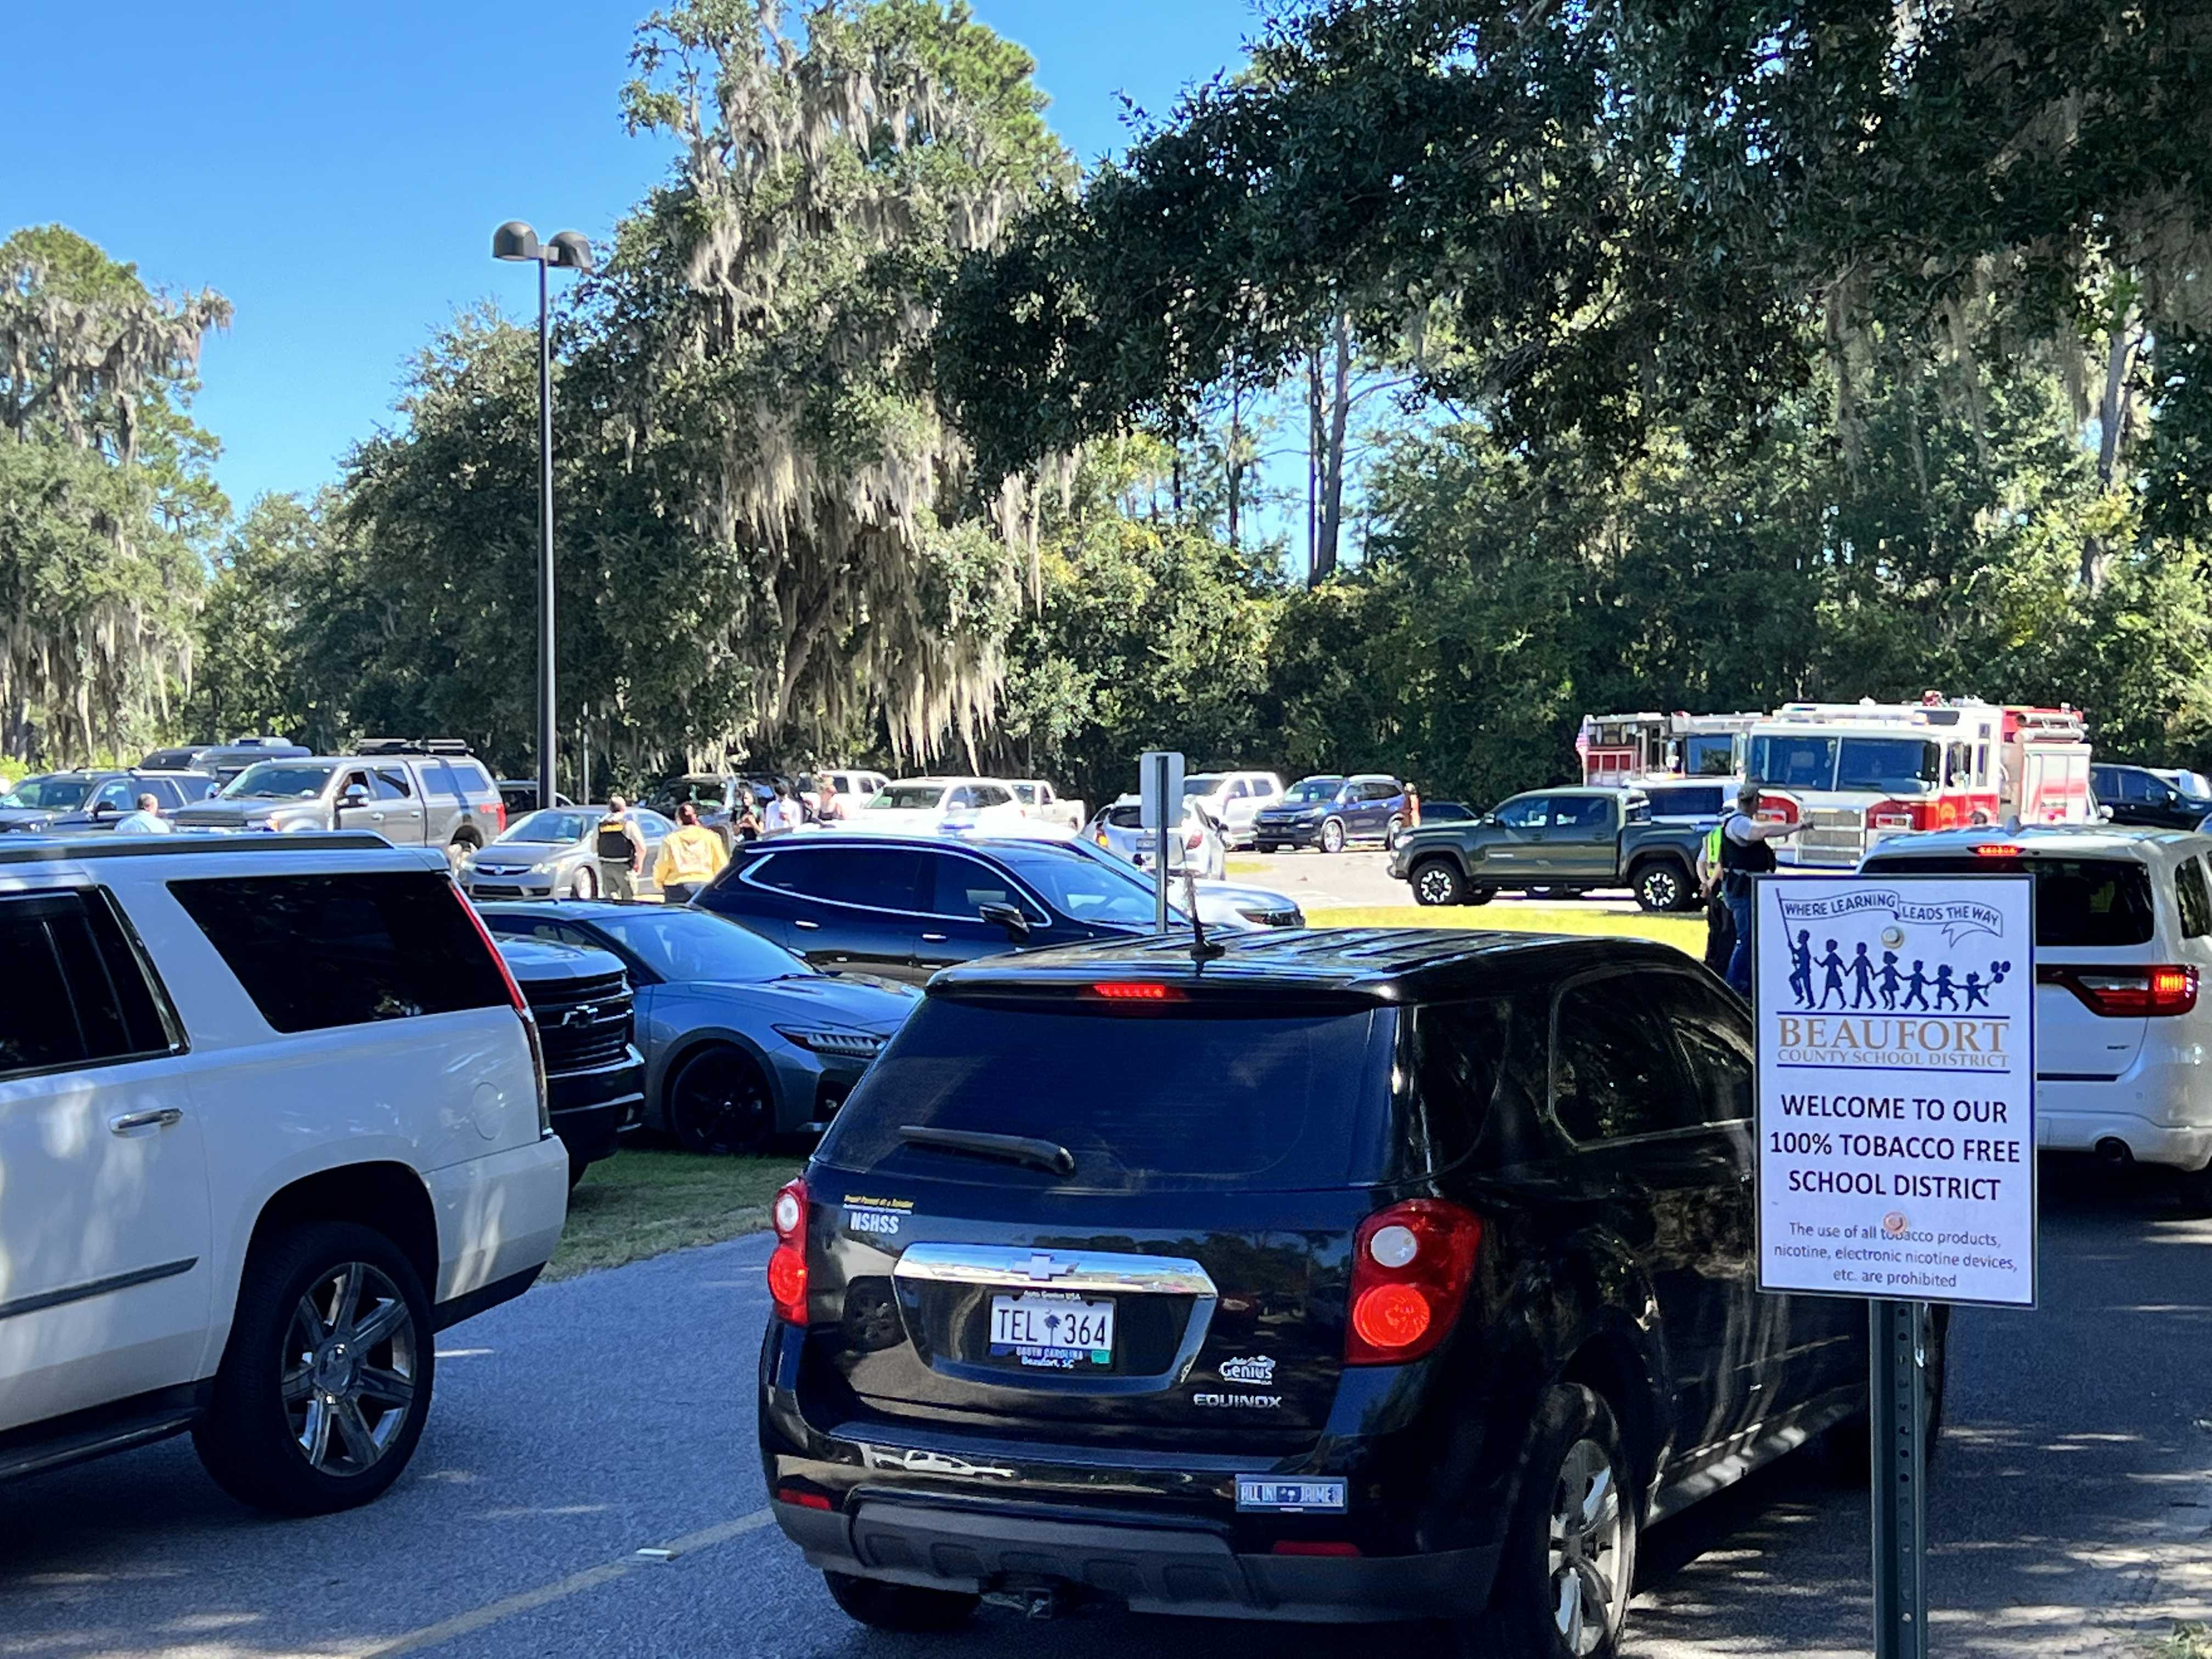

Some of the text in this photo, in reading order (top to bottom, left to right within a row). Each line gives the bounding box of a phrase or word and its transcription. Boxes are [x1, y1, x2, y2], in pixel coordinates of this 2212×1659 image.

[1785, 894, 1999, 926] WHERE LEARNING LEADS THE WAY
[1778, 1017, 2010, 1052] BEAUFORT
[1778, 1048, 2009, 1067] COUNTY SCHOOL DISTRICT
[1781, 1094, 2007, 1124] WELCOME TO OUR
[1770, 1132, 2021, 1163] 100% TOBACCO FREE
[1788, 1170, 2001, 1201] SCHOOL DISTRICT
[850, 1211, 900, 1234] NSHSS
[1790, 1222, 1814, 1236] The
[1818, 1226, 1840, 1238] use
[1844, 1225, 1858, 1238] of
[1861, 1225, 1877, 1239] all
[1938, 1231, 2001, 1248] products,
[1774, 1244, 2017, 1273] nicotine, electronic nicotine devices,
[1862, 1271, 1883, 1283] are
[1887, 1272, 1957, 1288] prohibited
[998, 1308, 1106, 1346] TEL 364
[1193, 1393, 1282, 1409] EQUINOX
